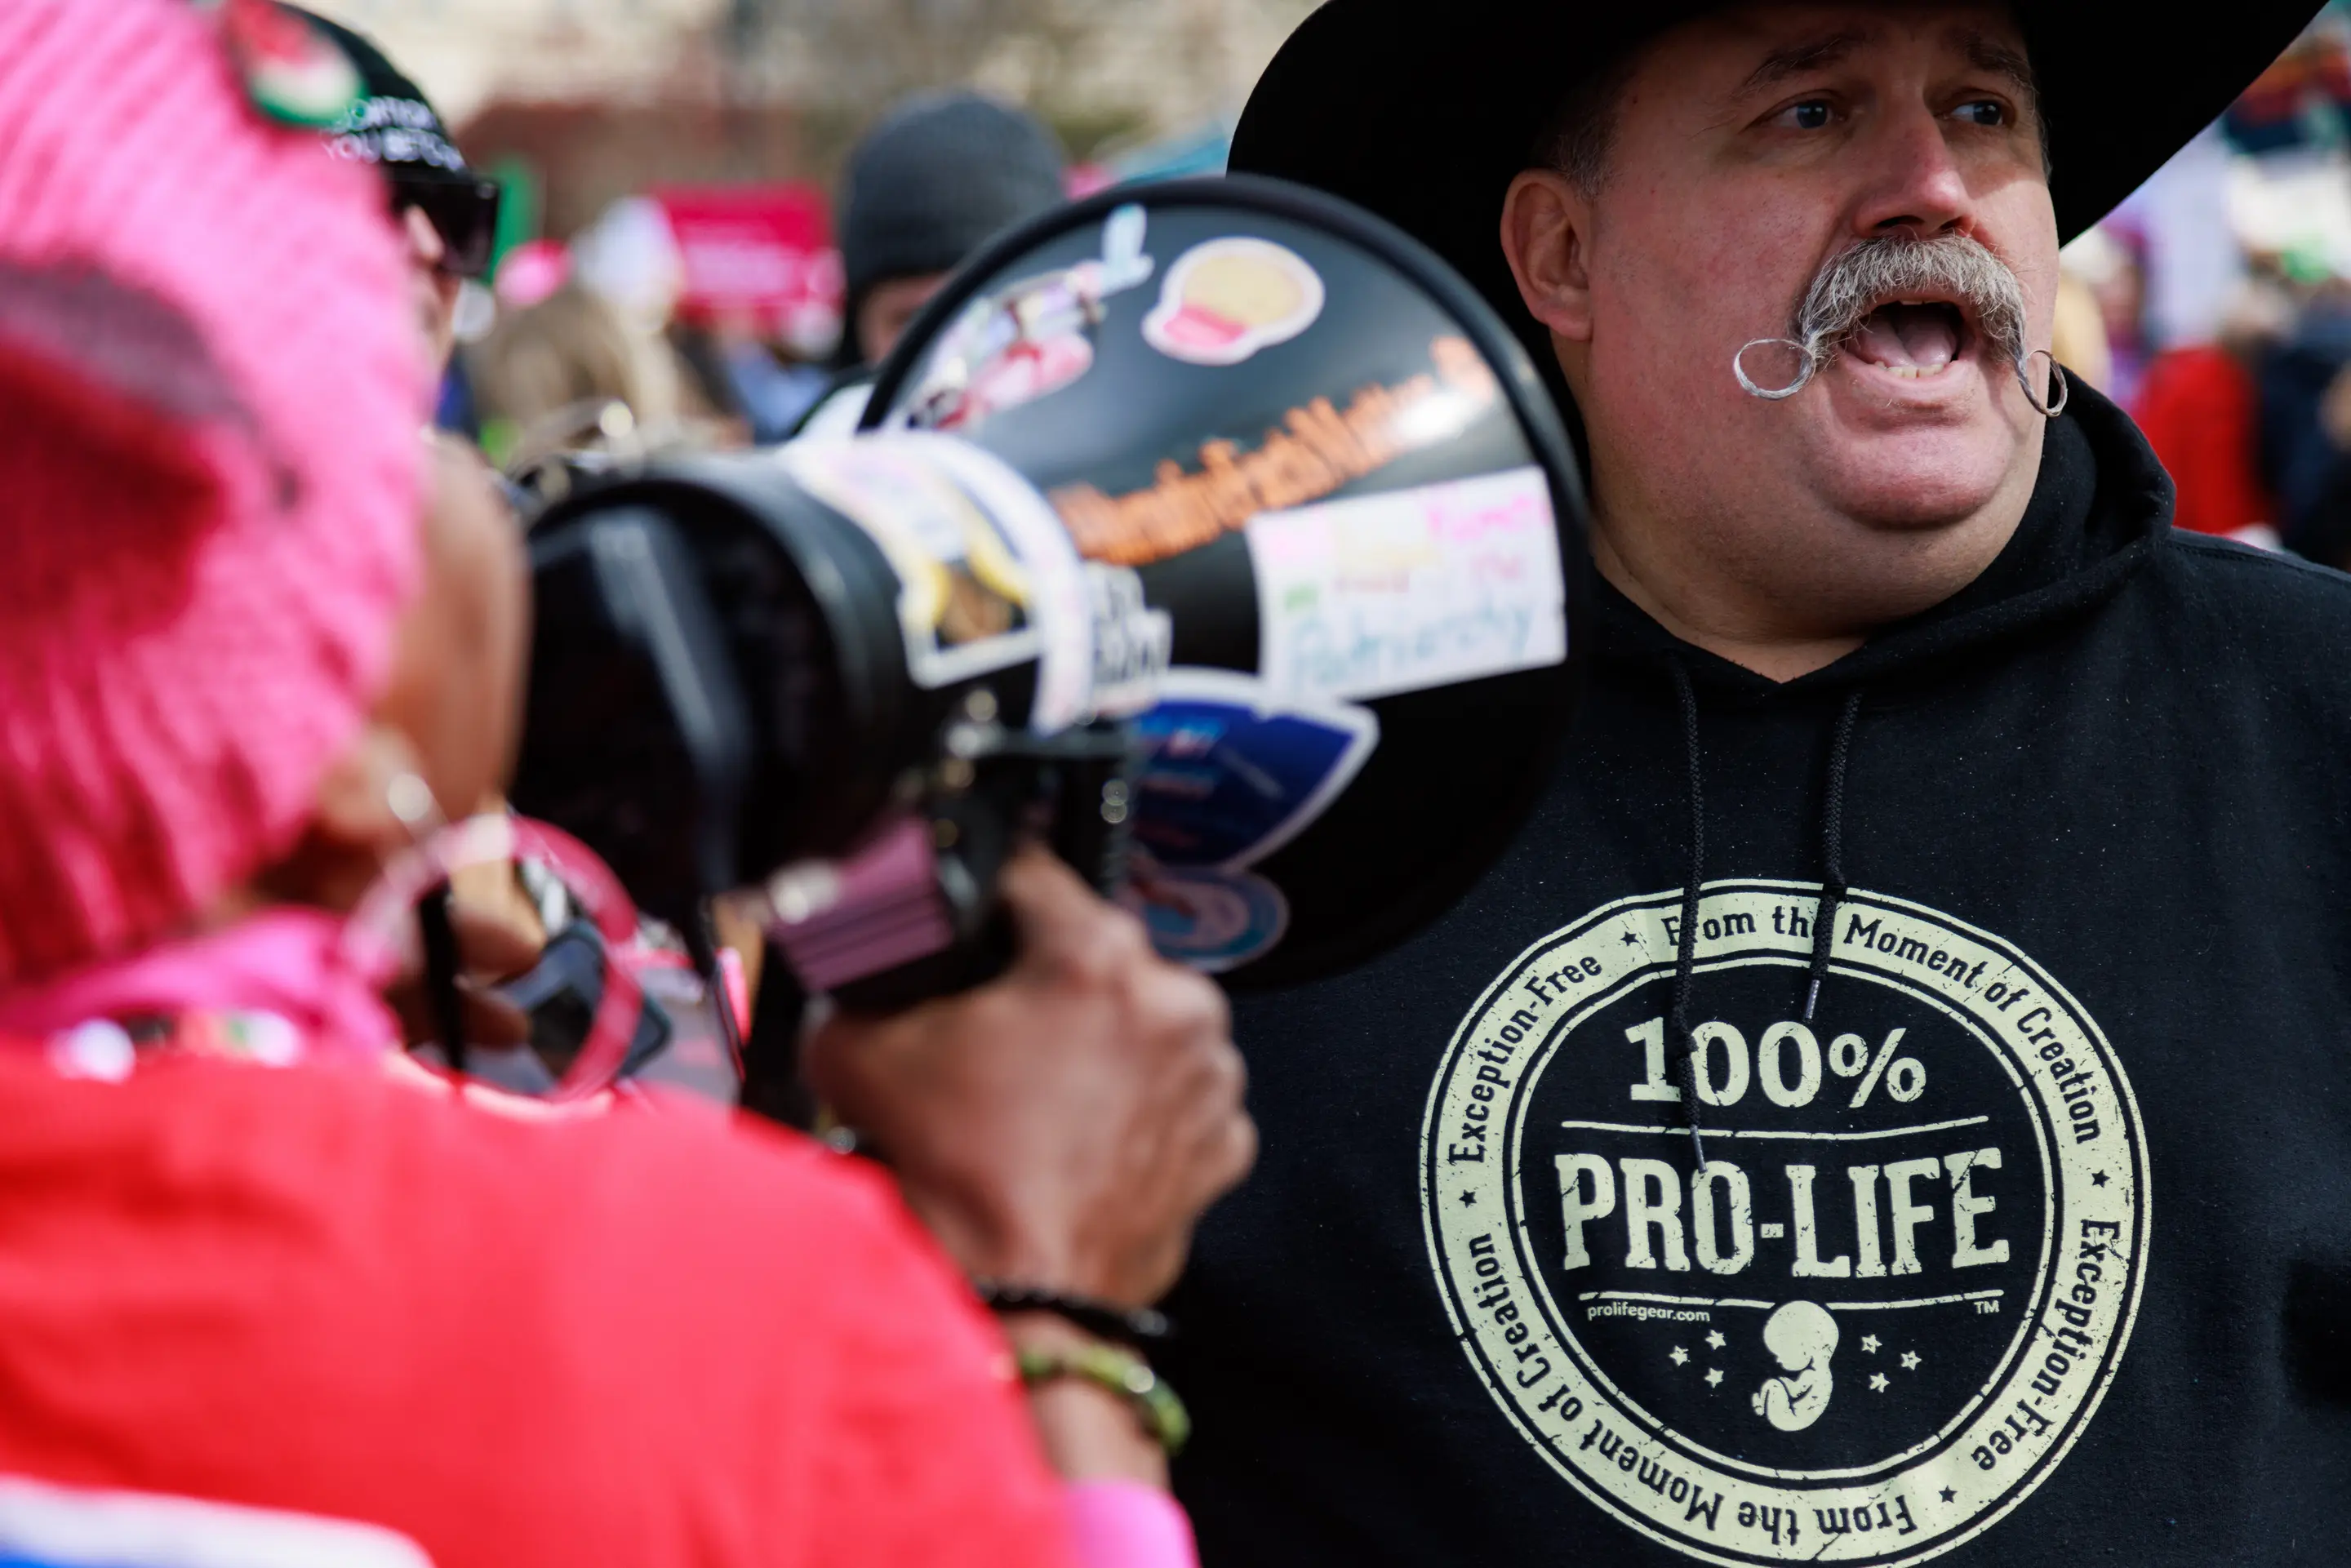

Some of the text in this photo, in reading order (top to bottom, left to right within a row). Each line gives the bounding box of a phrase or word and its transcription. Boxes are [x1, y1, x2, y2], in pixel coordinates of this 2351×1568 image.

[1449, 954, 1602, 1164] Exception-Free
[1624, 1017, 1927, 1108] 100%
[1661, 905, 2102, 1144] Fom th Moment of Creation
[1553, 1147, 2011, 1279] PRO-LIFE
[1469, 1233, 1918, 1546] From the Moment of Creation
[1586, 1301, 1711, 1322] prolifegear.com
[1971, 1219, 2121, 1471] Exception-Free
[1973, 1299, 2000, 1314] TM
